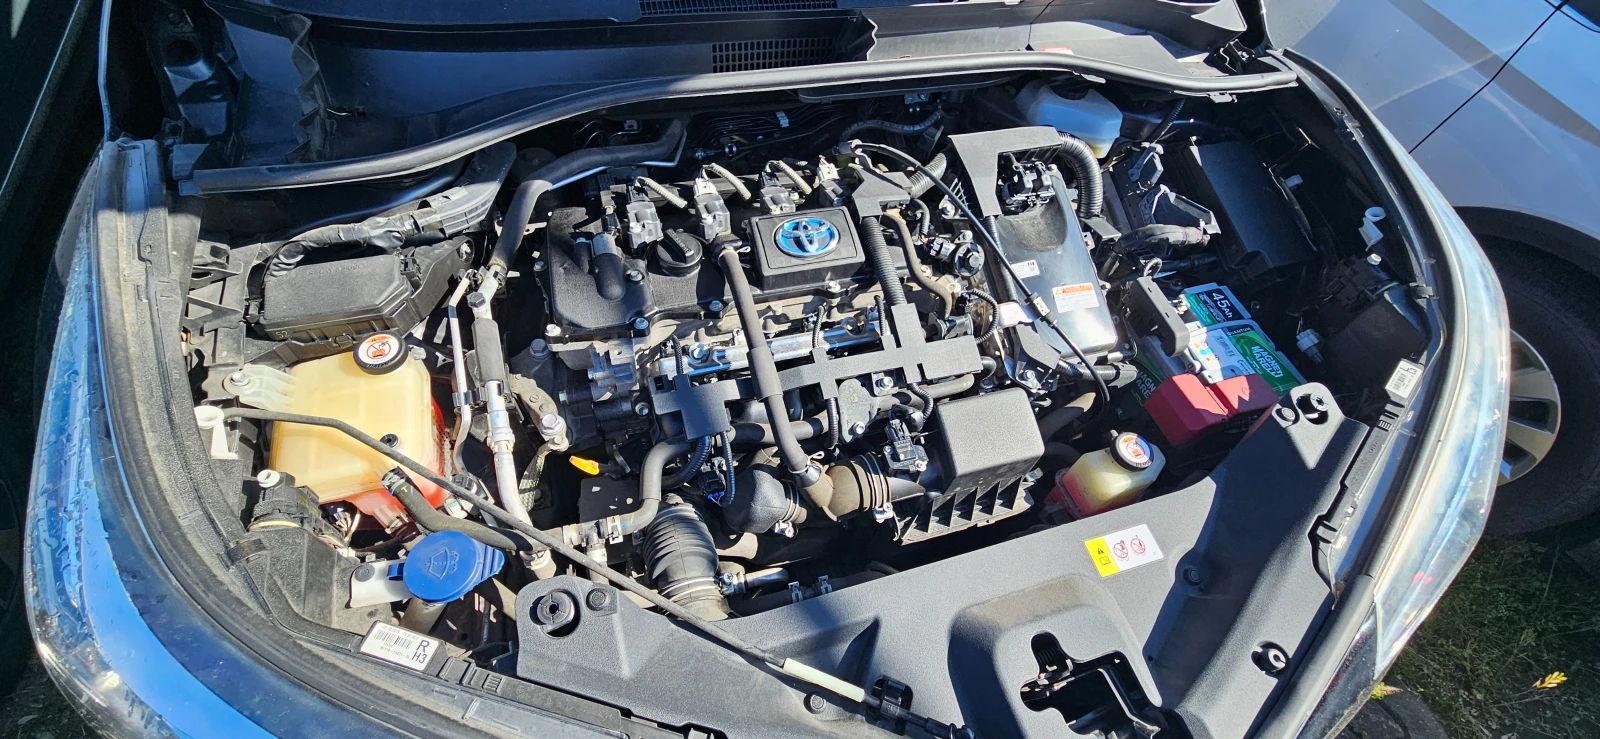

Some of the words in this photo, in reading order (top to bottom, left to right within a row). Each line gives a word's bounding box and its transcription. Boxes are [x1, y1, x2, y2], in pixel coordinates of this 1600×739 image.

[1212, 292, 1233, 318] 45Ah
[1251, 345, 1283, 376] MAGNETI
[1252, 350, 1283, 378] MARELLI
[411, 651, 427, 663] H3
[416, 639, 430, 653] R
